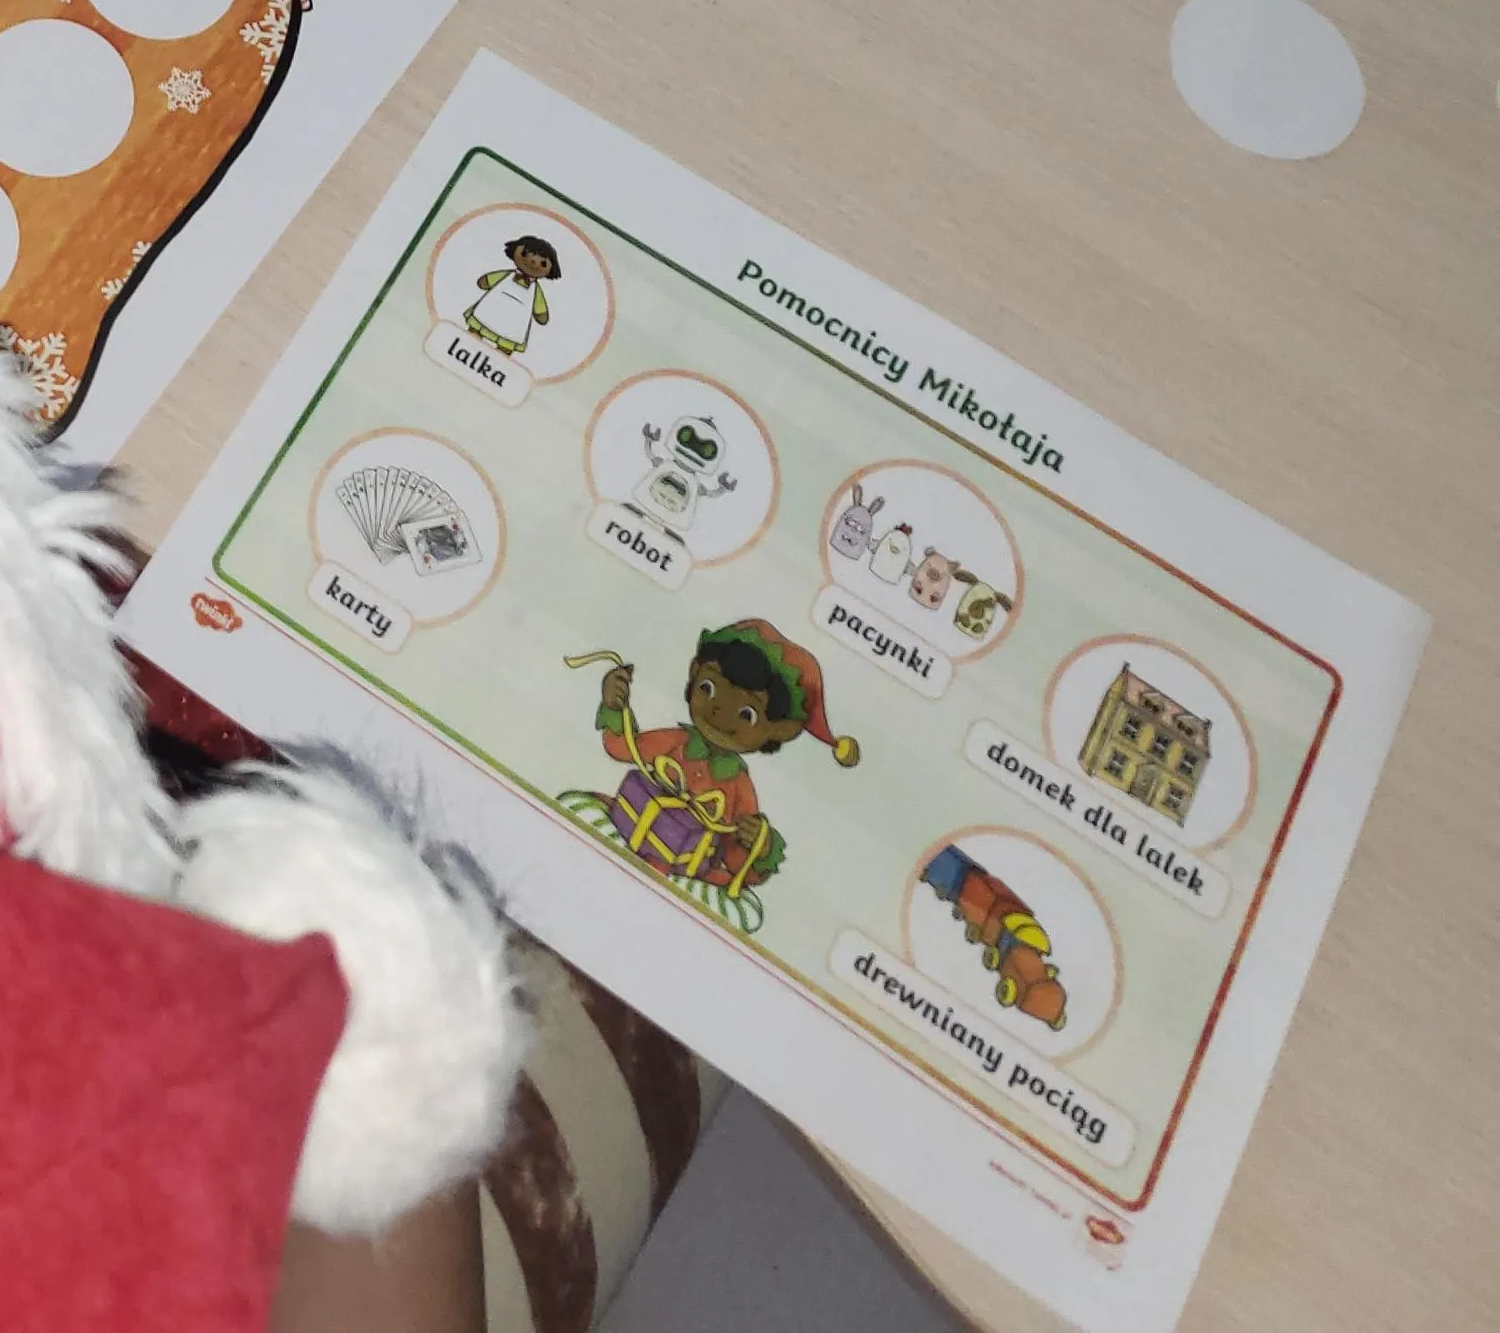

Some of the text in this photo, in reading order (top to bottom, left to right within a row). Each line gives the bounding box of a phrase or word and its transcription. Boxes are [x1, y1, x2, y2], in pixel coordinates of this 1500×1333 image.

[446, 337, 507, 389] lalka
[736, 259, 1066, 475] Pomocnicy Mikołaja
[604, 516, 674, 573] robot
[324, 575, 394, 638] karty
[826, 602, 936, 679] pacynki
[986, 740, 1205, 898] domek dla lalek
[853, 952, 1110, 1145] drewniany pociąg
